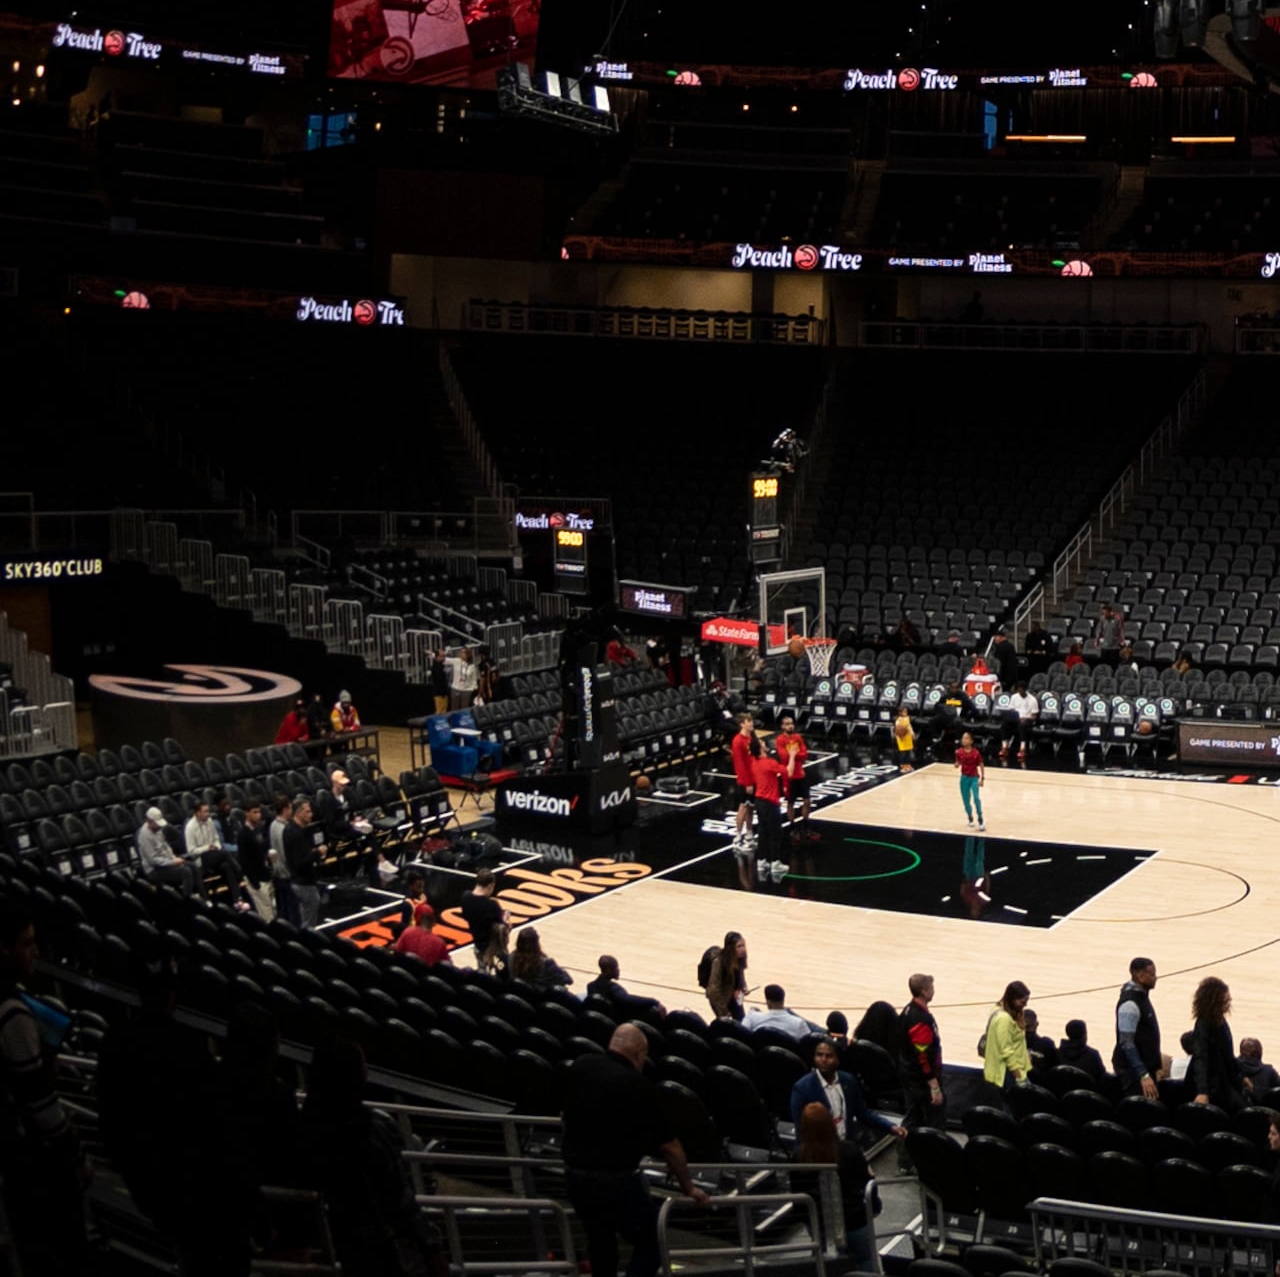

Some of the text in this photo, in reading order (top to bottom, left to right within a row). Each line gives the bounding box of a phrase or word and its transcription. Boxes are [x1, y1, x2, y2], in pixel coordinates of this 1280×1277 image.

[54, 24, 161, 59] Peach Tree
[844, 68, 958, 90] Peach Tree
[732, 244, 862, 270] Peach Tree
[968, 253, 1005, 272] planet
[973, 261, 1013, 272] fitness
[297, 298, 403, 325] Peach Tre
[515, 512, 594, 530] Peach Tree
[1190, 737, 1266, 750] GAME PRESENTED BY
[505, 790, 570, 816] verizon
